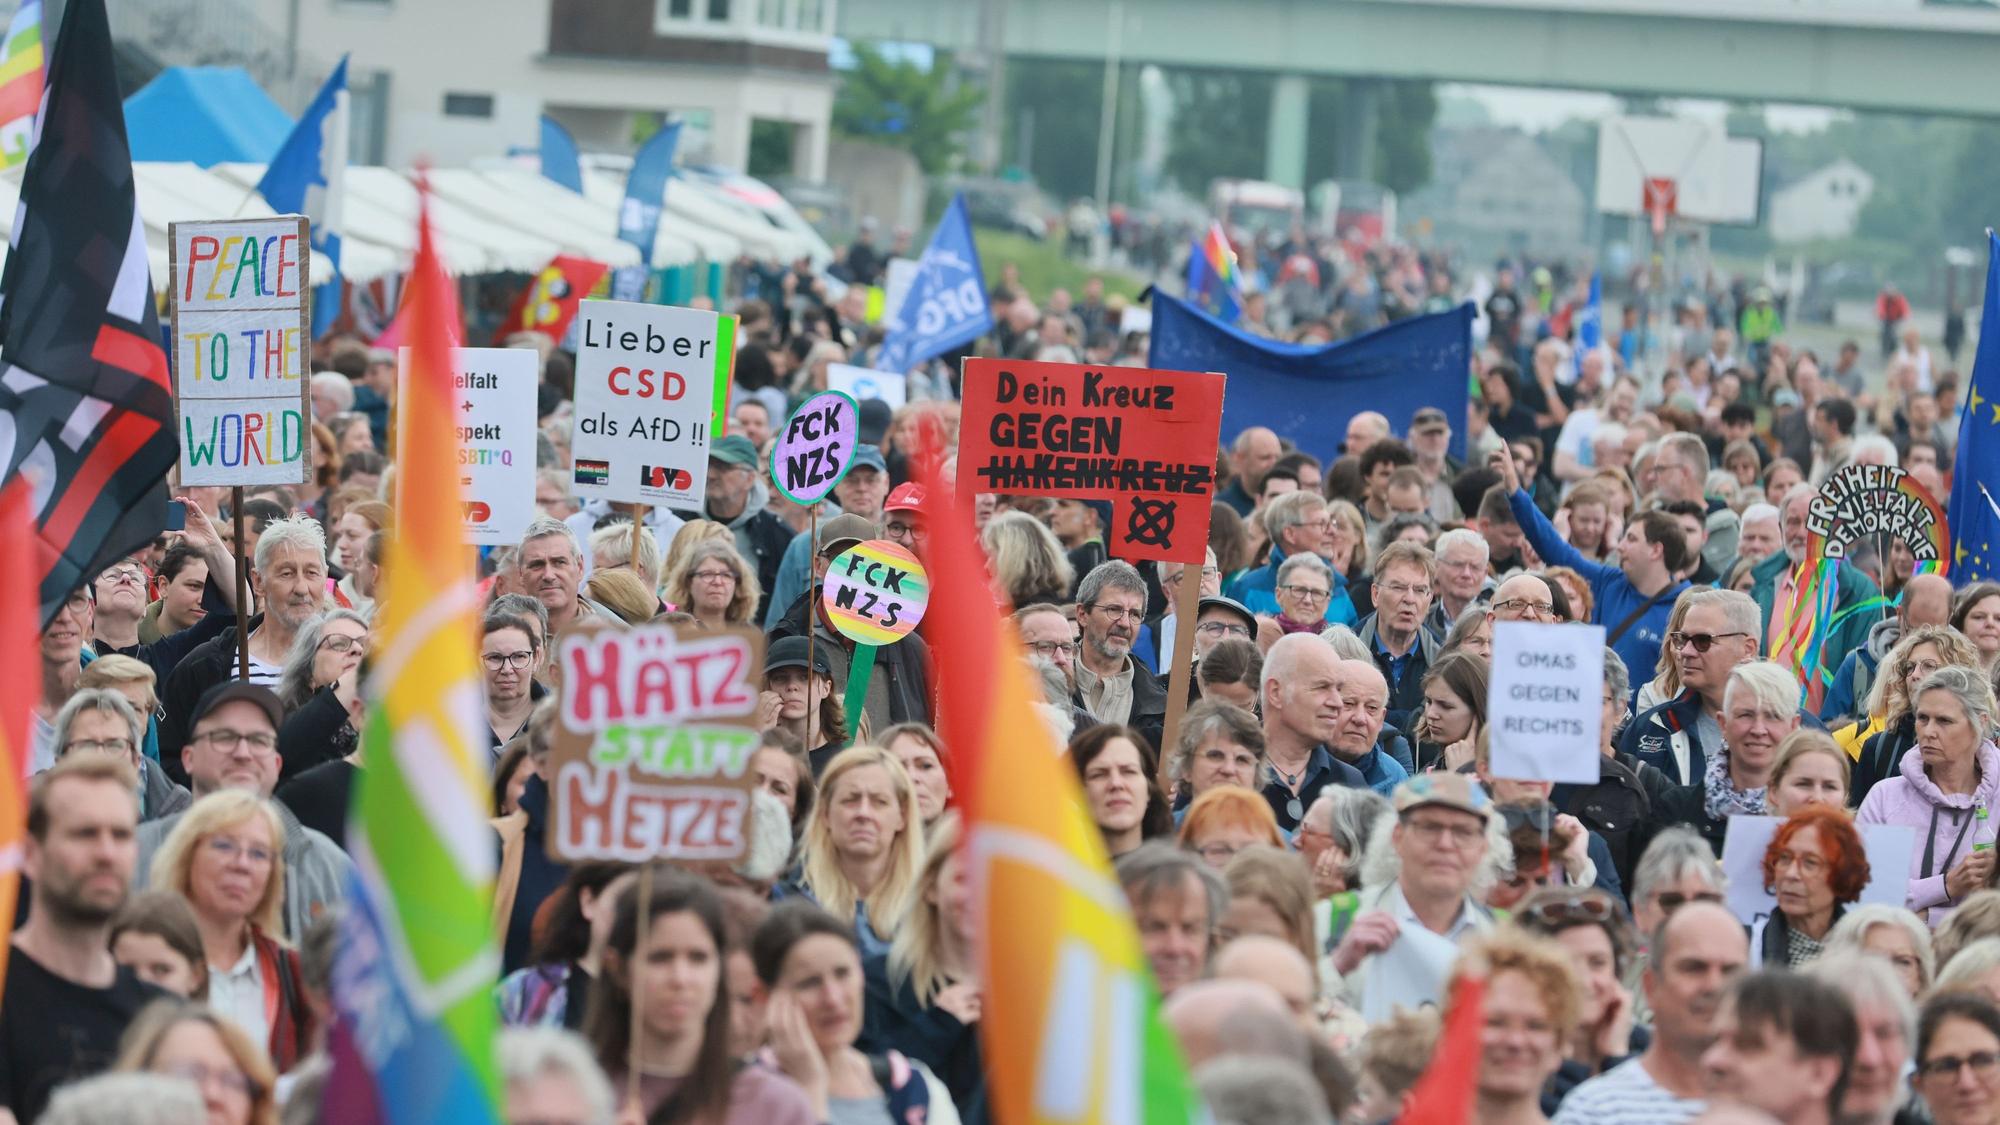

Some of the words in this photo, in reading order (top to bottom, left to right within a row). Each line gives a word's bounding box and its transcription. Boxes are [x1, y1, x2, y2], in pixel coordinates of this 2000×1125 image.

[185, 235, 298, 302] PEACE
[184, 332, 229, 381] TO
[241, 328, 300, 379] THE
[585, 319, 711, 358] Lieber
[451, 373, 498, 389] ielfalt
[608, 366, 686, 401] CSD
[996, 371, 1066, 406] Dein
[1082, 372, 1175, 410] Kreuz
[186, 410, 303, 467] WORLD
[456, 424, 501, 442] spekt
[581, 412, 618, 436] als
[628, 416, 681, 442] AfD
[787, 402, 842, 444] FCK
[990, 413, 1122, 455] GEGEN
[458, 449, 513, 467] SBTIQ
[787, 452, 841, 491] NZS
[988, 454, 1210, 494] HAKENKREUZ
[1806, 464, 1909, 537] FREIHEIT
[1837, 490, 1935, 529] VIELFALT
[1823, 511, 1938, 560] DEMOKRATIE
[846, 553, 908, 594] FCK
[835, 584, 902, 627] NZS
[571, 636, 748, 721] HÄTZ
[1516, 652, 1577, 669] OMAS
[1509, 683, 1580, 702] GEGEN
[1504, 716, 1584, 736] RECHTS
[599, 724, 755, 772] STATT
[568, 769, 738, 849] HETZE
